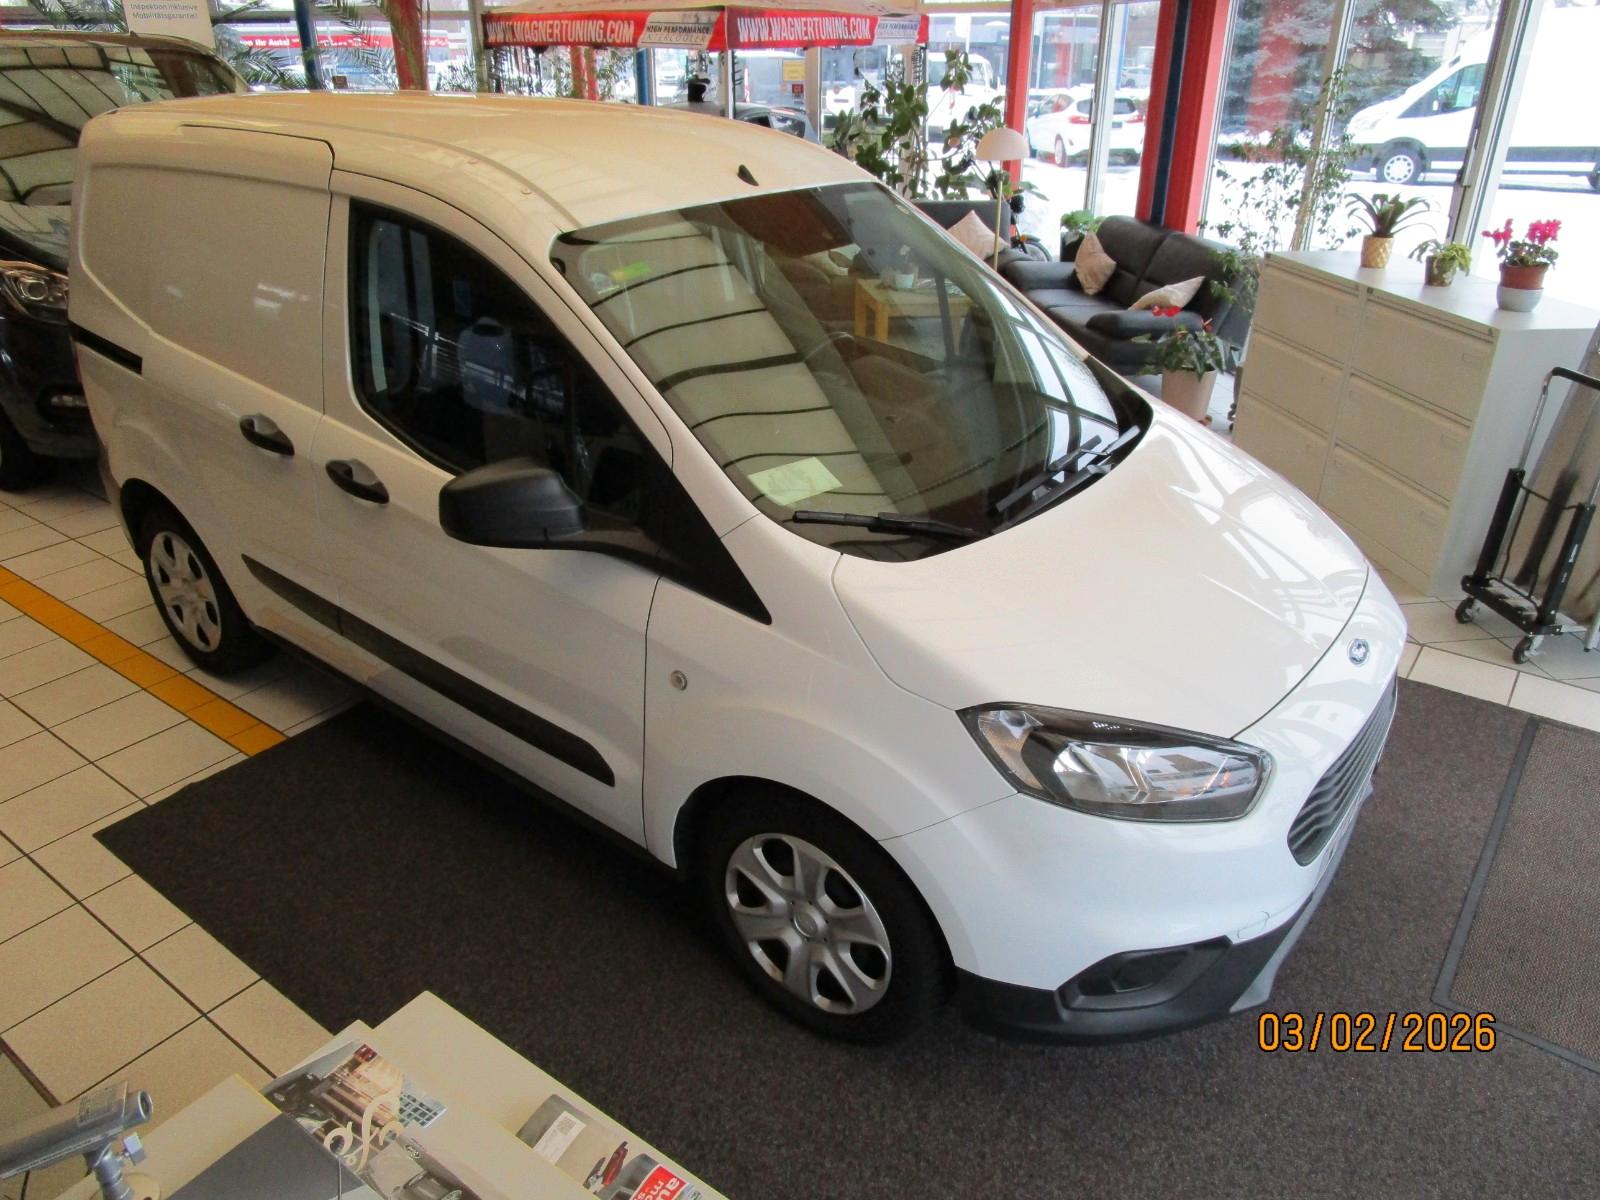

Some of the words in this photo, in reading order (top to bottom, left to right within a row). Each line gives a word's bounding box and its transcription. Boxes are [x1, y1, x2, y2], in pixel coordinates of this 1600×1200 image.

[486, 19, 635, 43] WWW.WAGNERTUNING.COM
[646, 25, 662, 33] HIGH
[663, 25, 710, 34] PERFORMANCE
[737, 17, 871, 43] WWW.WAGNERTUNING.COM
